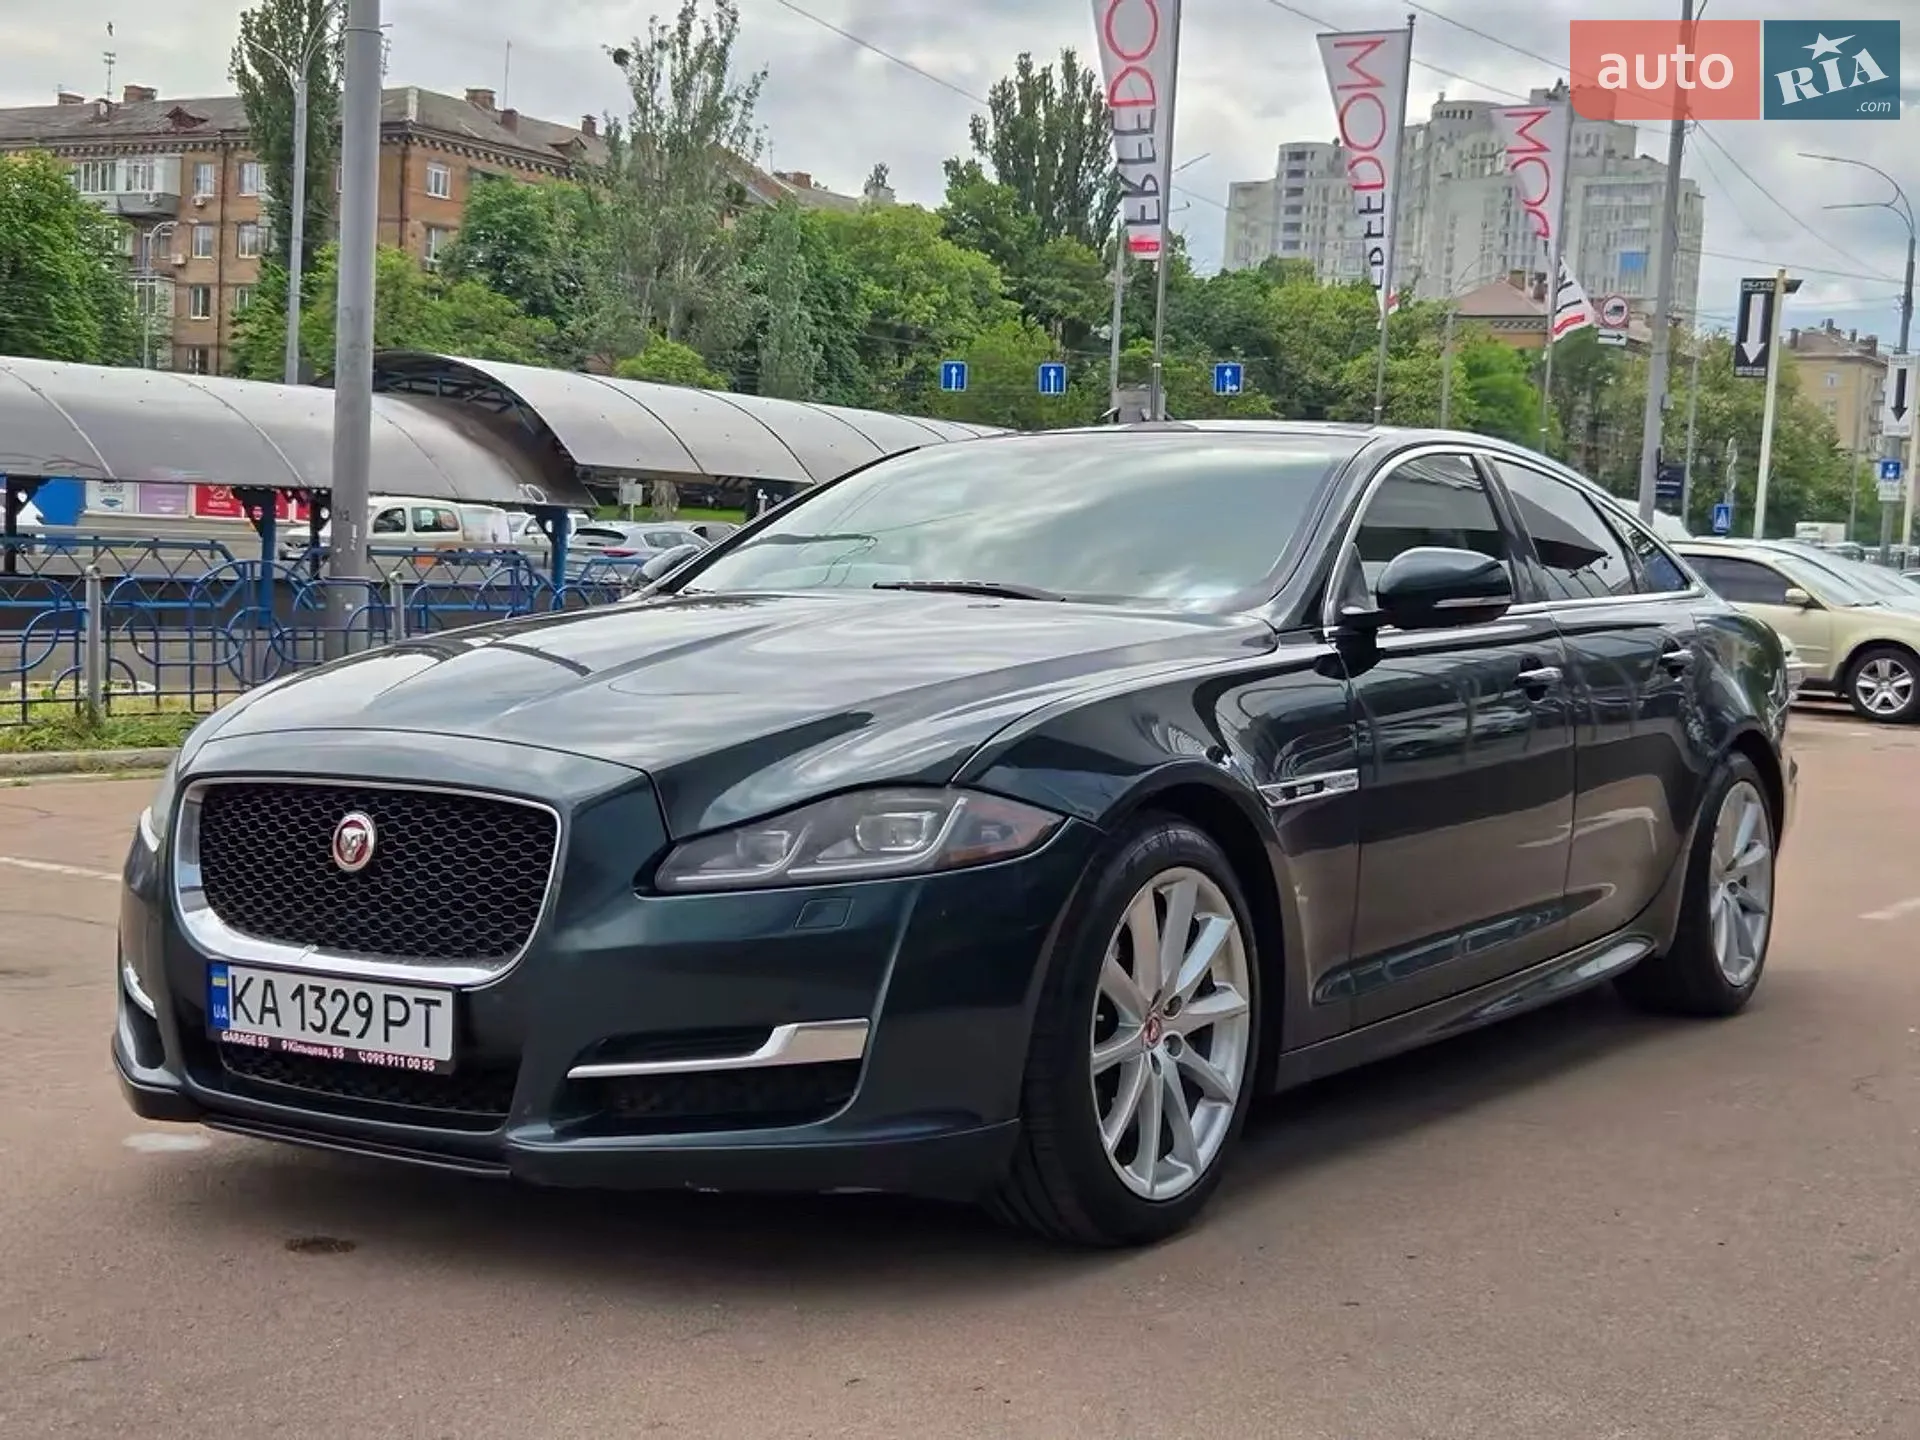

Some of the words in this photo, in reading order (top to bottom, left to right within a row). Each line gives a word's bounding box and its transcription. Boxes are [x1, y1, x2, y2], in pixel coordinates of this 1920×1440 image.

[213, 1005, 229, 1020] UA
[230, 974, 282, 1027] KA
[290, 983, 374, 1039] 1329
[383, 993, 442, 1048] PT
[222, 1031, 256, 1047] GARAGE
[257, 1036, 269, 1049] 55
[366, 1052, 385, 1065] 095
[386, 1054, 405, 1068] 911
[407, 1058, 420, 1070] 00
[422, 1060, 435, 1071] 55
